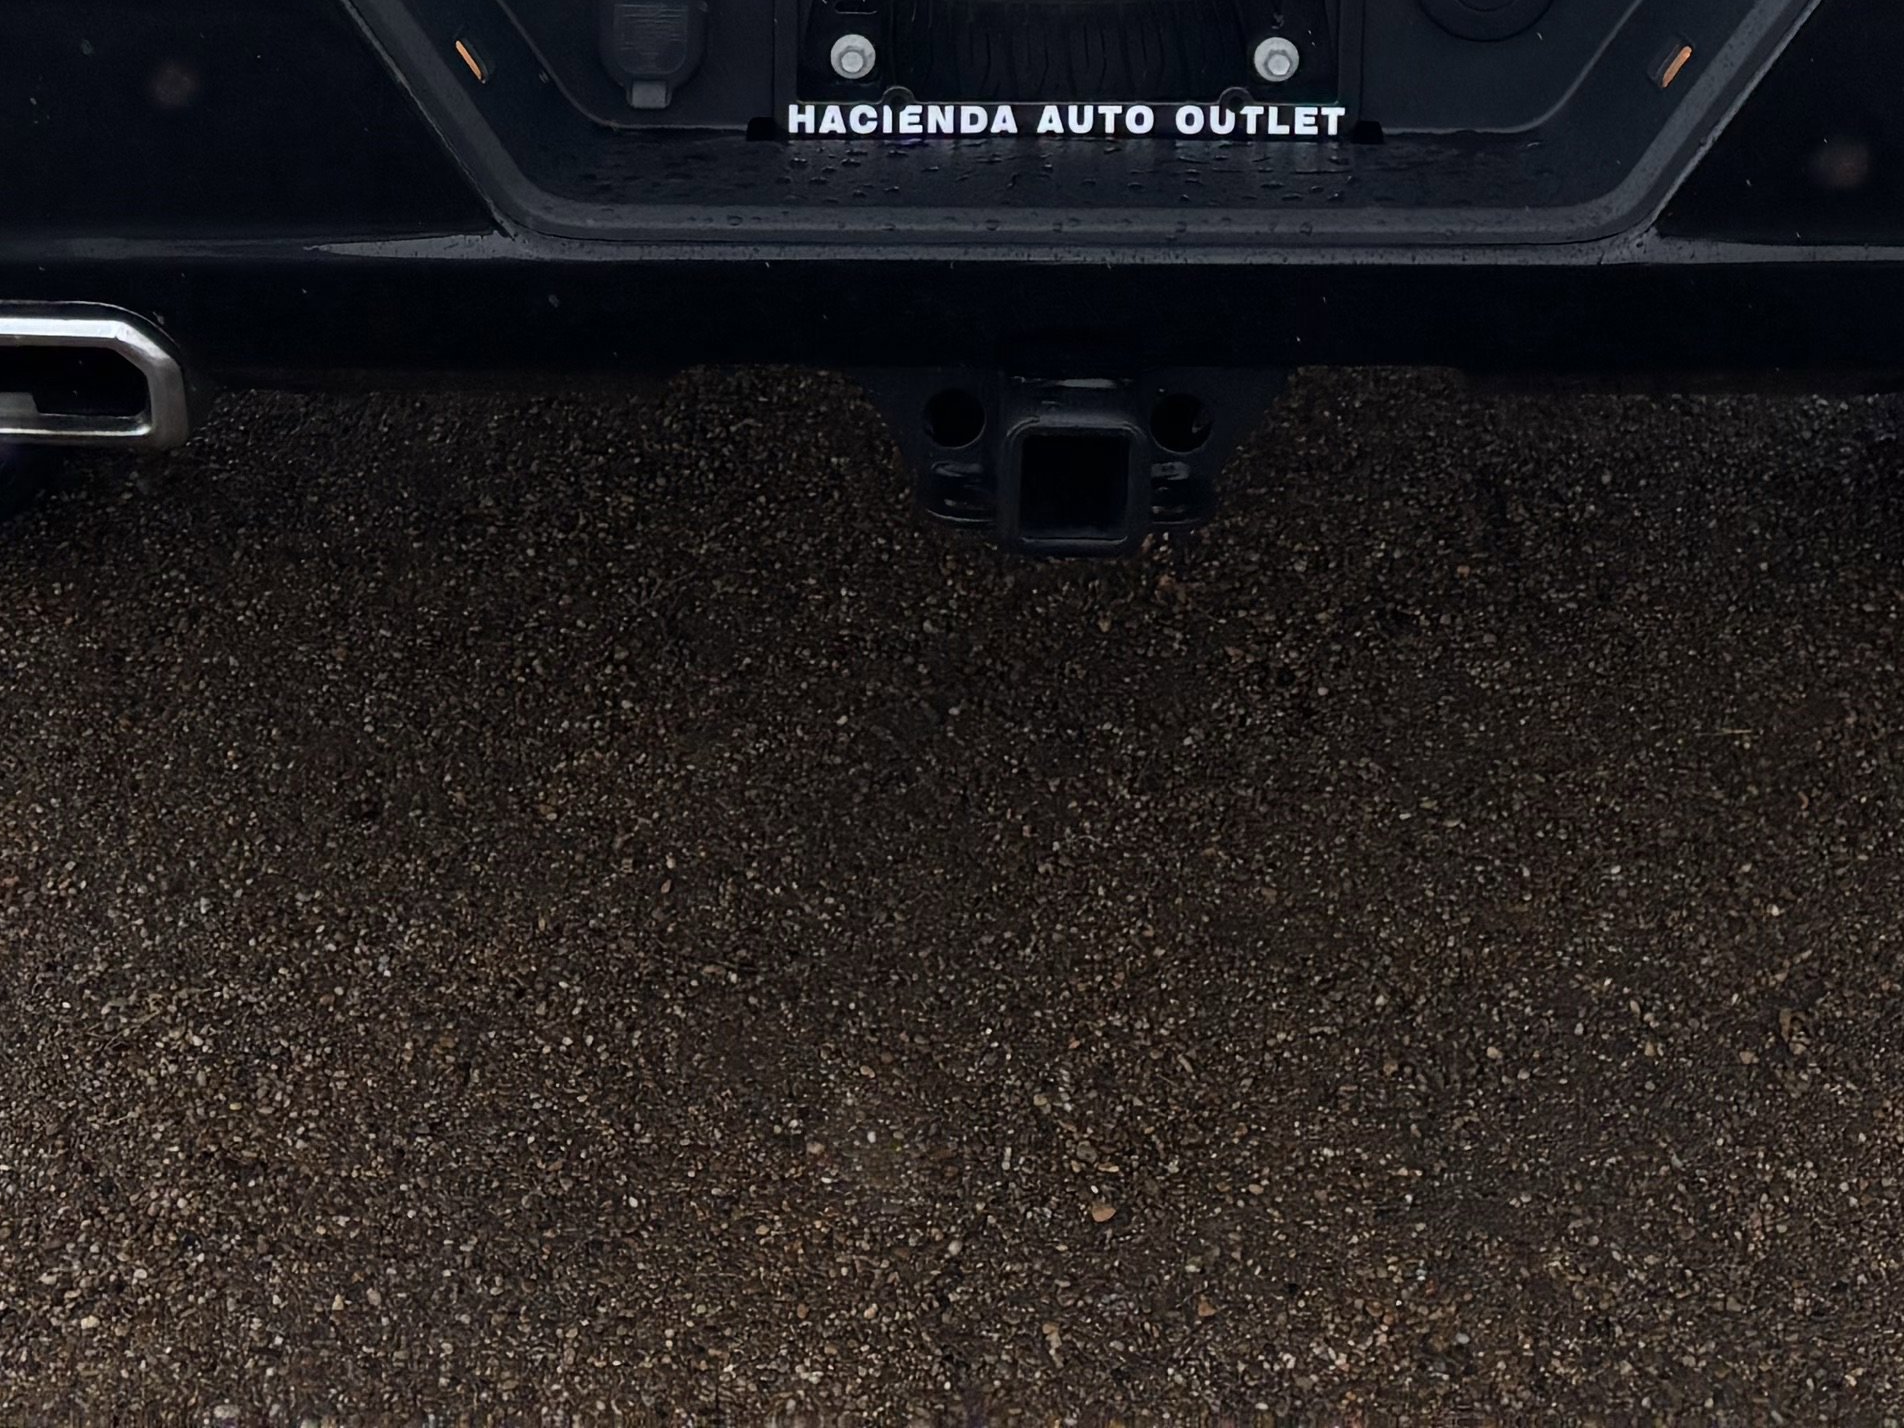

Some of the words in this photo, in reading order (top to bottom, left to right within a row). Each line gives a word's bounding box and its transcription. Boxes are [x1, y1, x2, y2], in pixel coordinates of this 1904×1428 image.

[787, 104, 1019, 135] HACIENDA
[1036, 104, 1154, 135] AUTO
[1174, 104, 1346, 136] OUTLET
